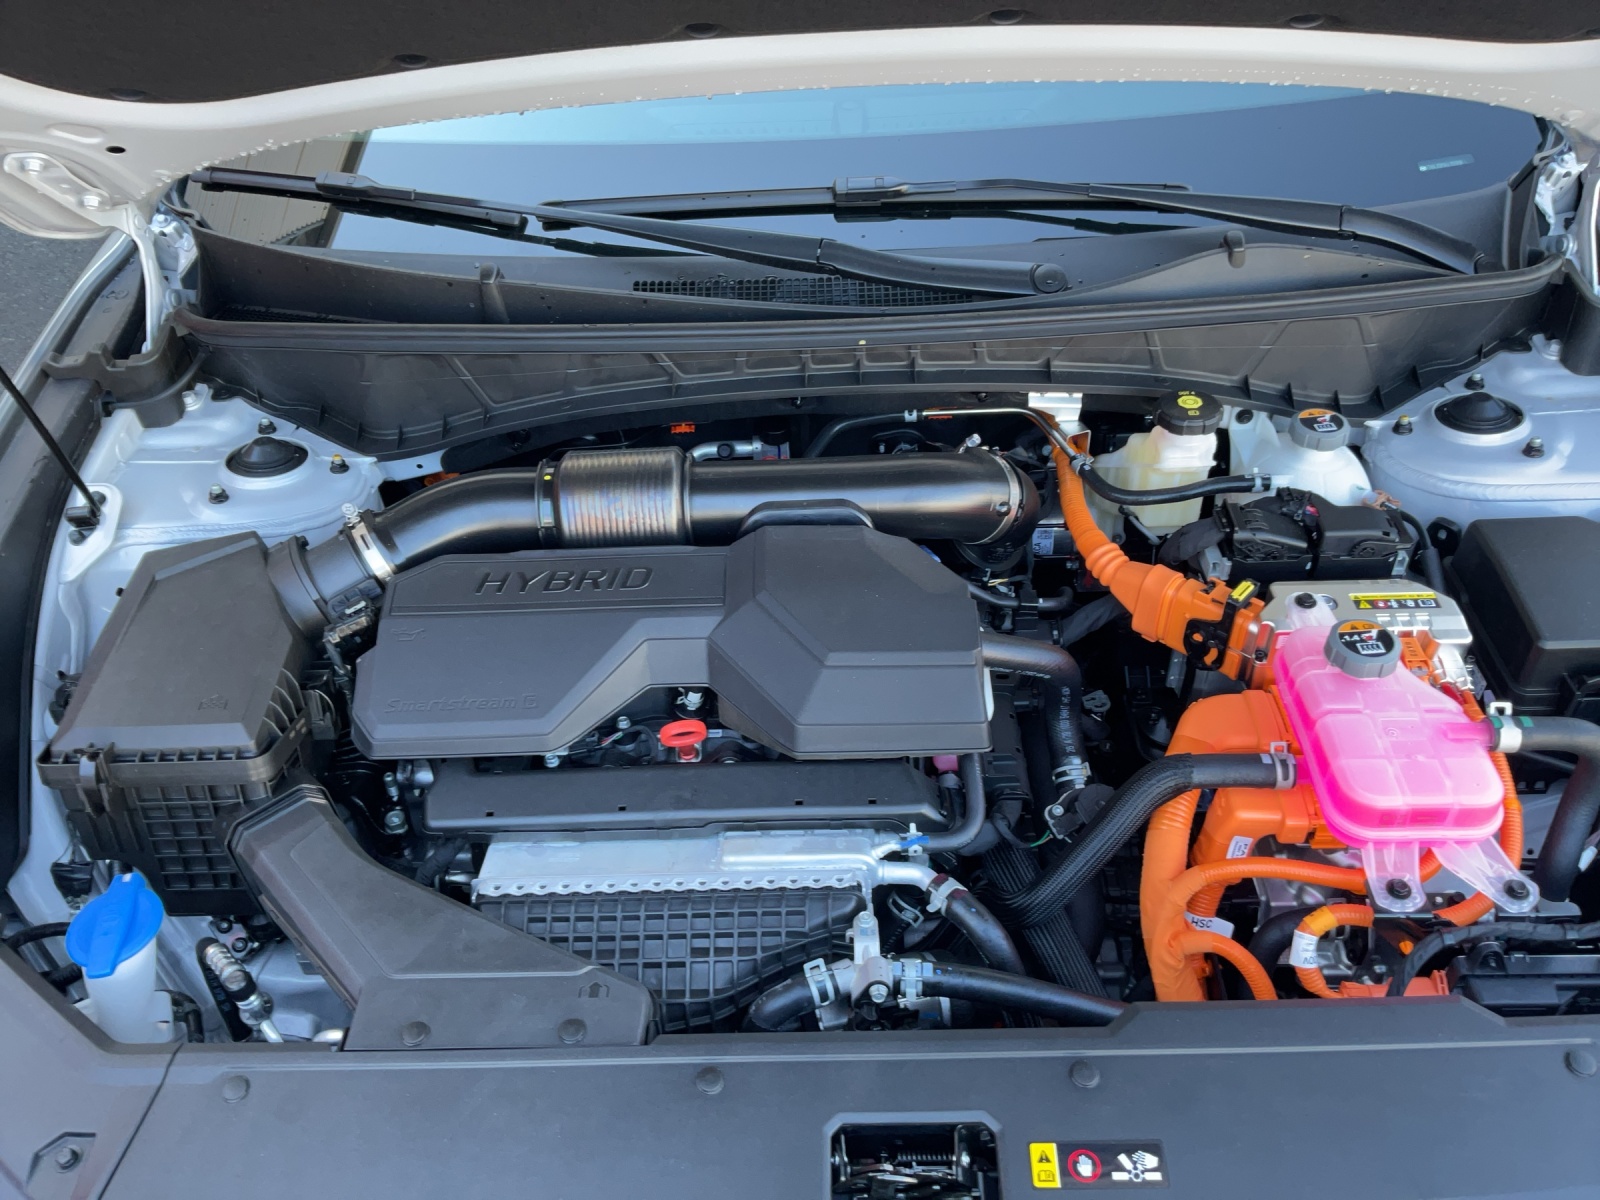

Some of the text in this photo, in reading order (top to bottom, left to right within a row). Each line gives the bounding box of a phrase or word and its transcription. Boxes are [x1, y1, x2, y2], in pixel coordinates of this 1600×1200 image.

[474, 567, 654, 596] HYBRID
[384, 696, 517, 713] Smartstream
[1190, 916, 1213, 929] HSC
